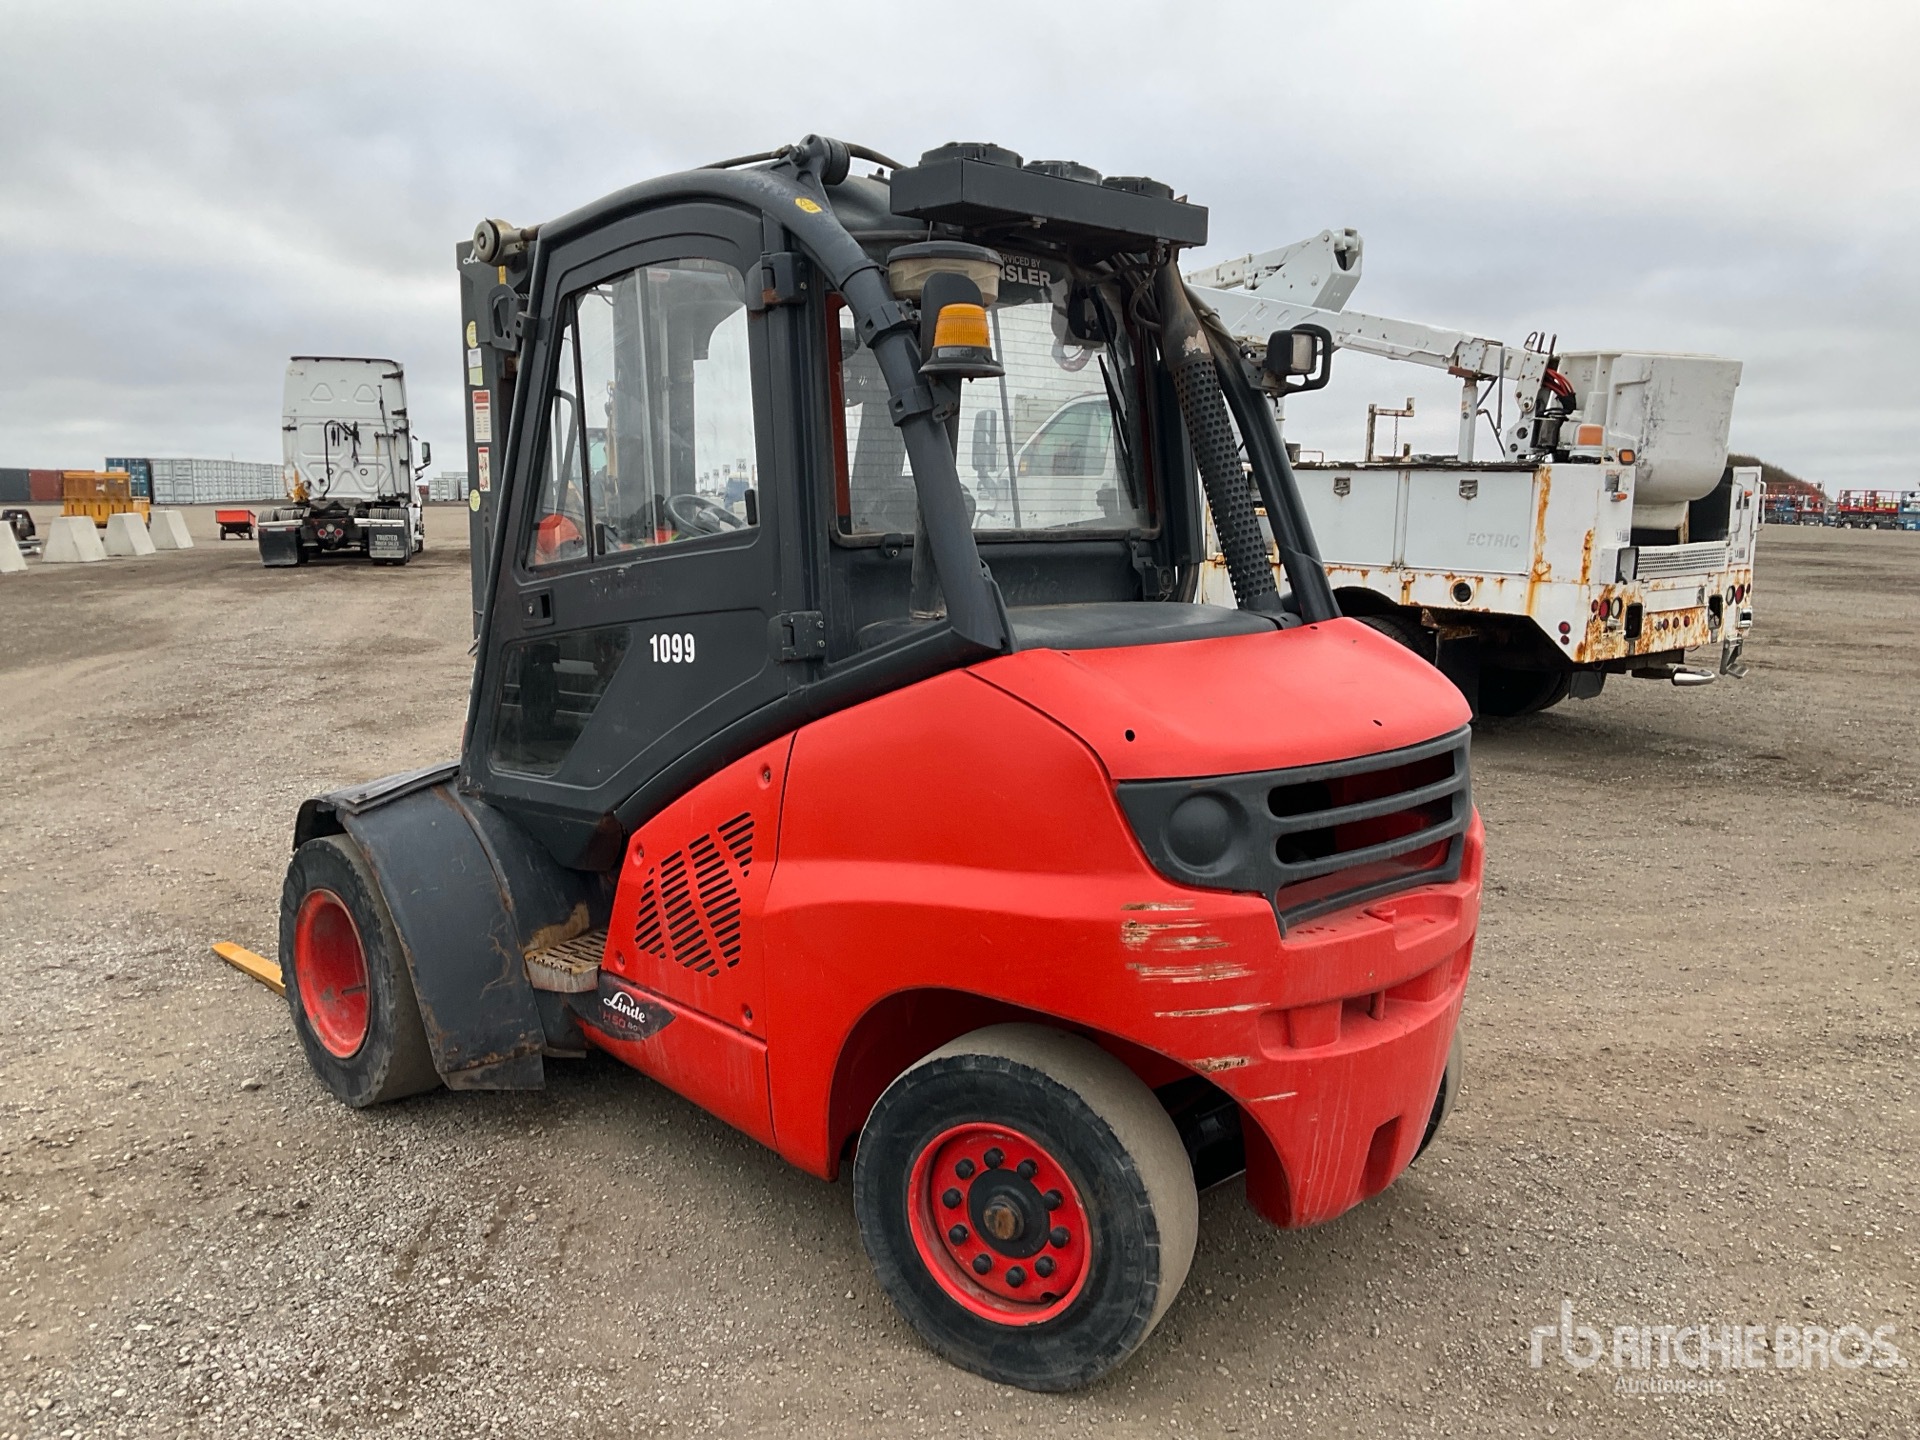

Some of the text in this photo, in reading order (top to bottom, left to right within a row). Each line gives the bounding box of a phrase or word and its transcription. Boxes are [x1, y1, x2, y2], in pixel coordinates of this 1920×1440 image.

[1000, 253, 1041, 268] RVICED BY
[1466, 532, 1520, 548] ECTRIC
[649, 633, 695, 663] 1099
[603, 991, 647, 1024] Linde
